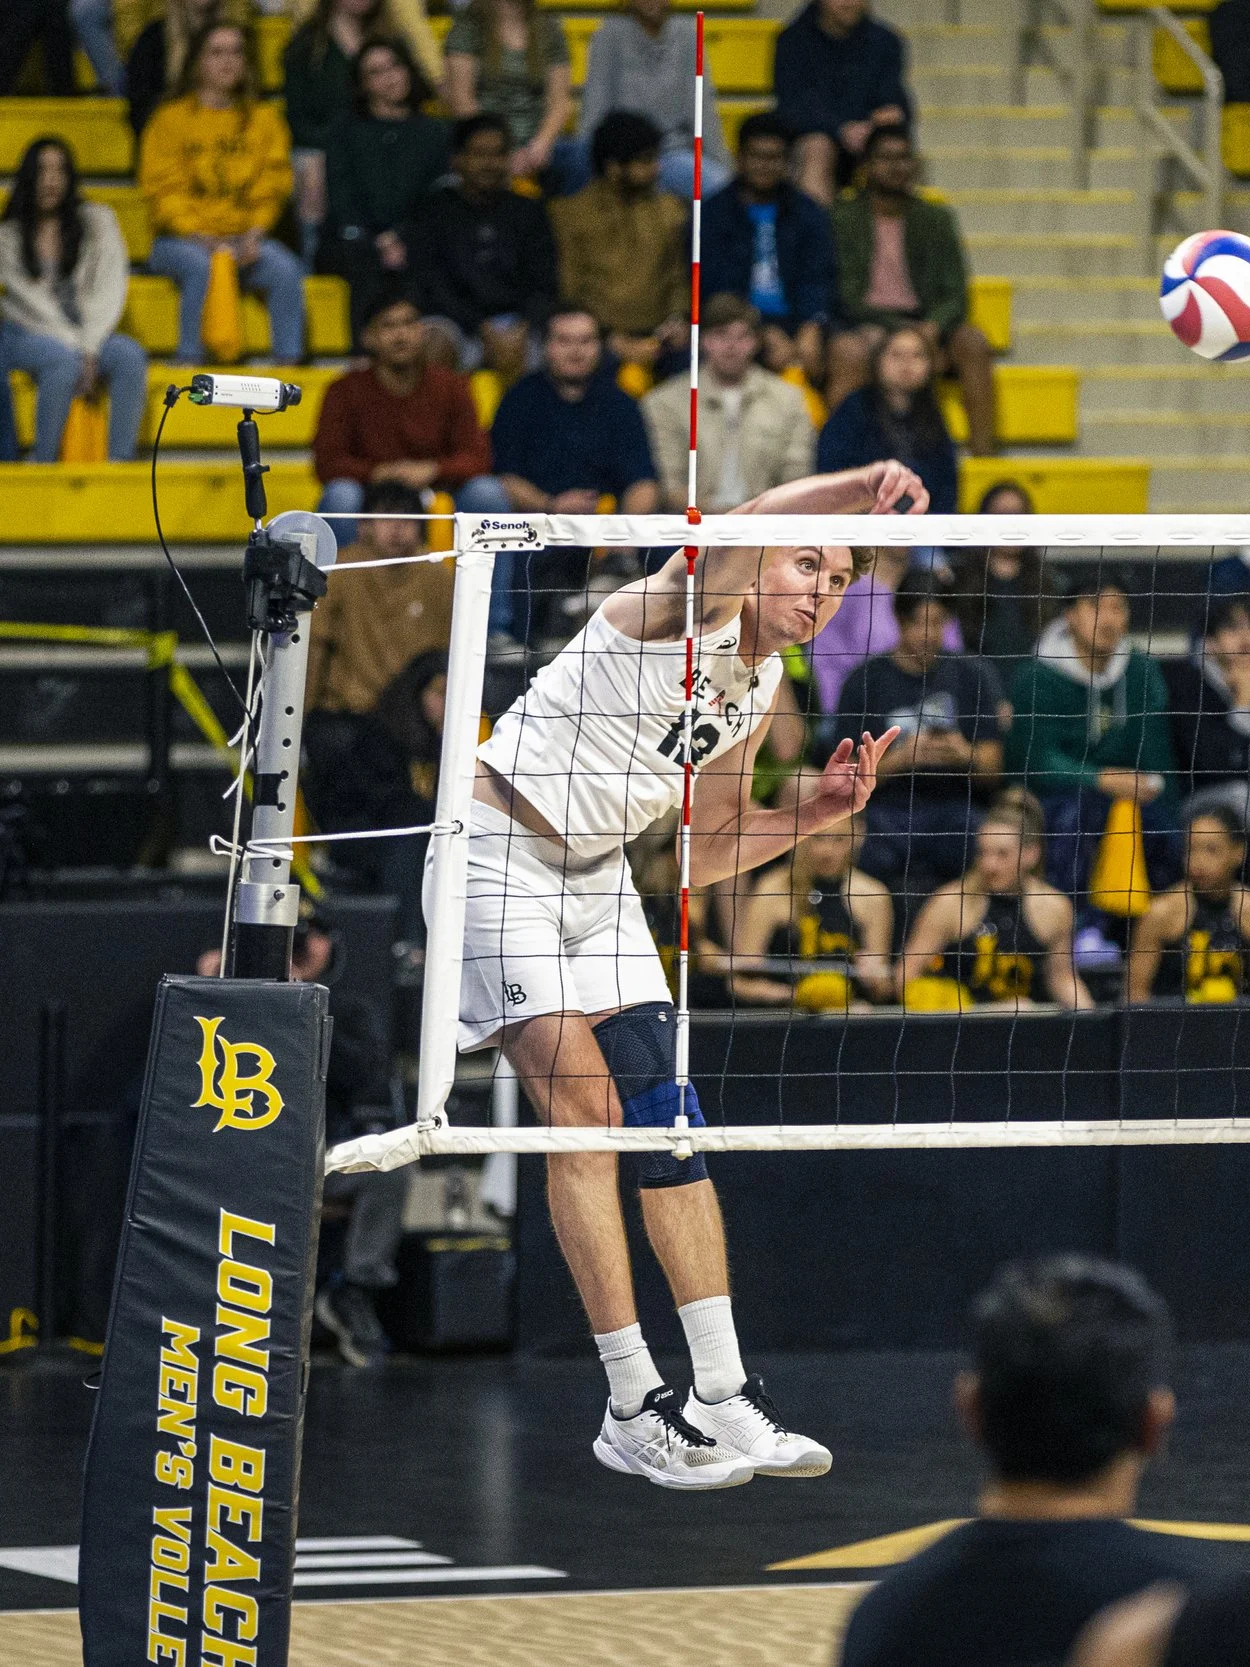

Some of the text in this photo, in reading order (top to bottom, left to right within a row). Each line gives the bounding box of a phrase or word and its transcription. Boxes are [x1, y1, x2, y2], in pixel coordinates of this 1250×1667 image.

[492, 521, 530, 530] Senoh
[189, 1015, 285, 1133] LB
[147, 1315, 201, 1667] MEN'S VOLLE
[201, 1206, 276, 1667] LONG BEACH
